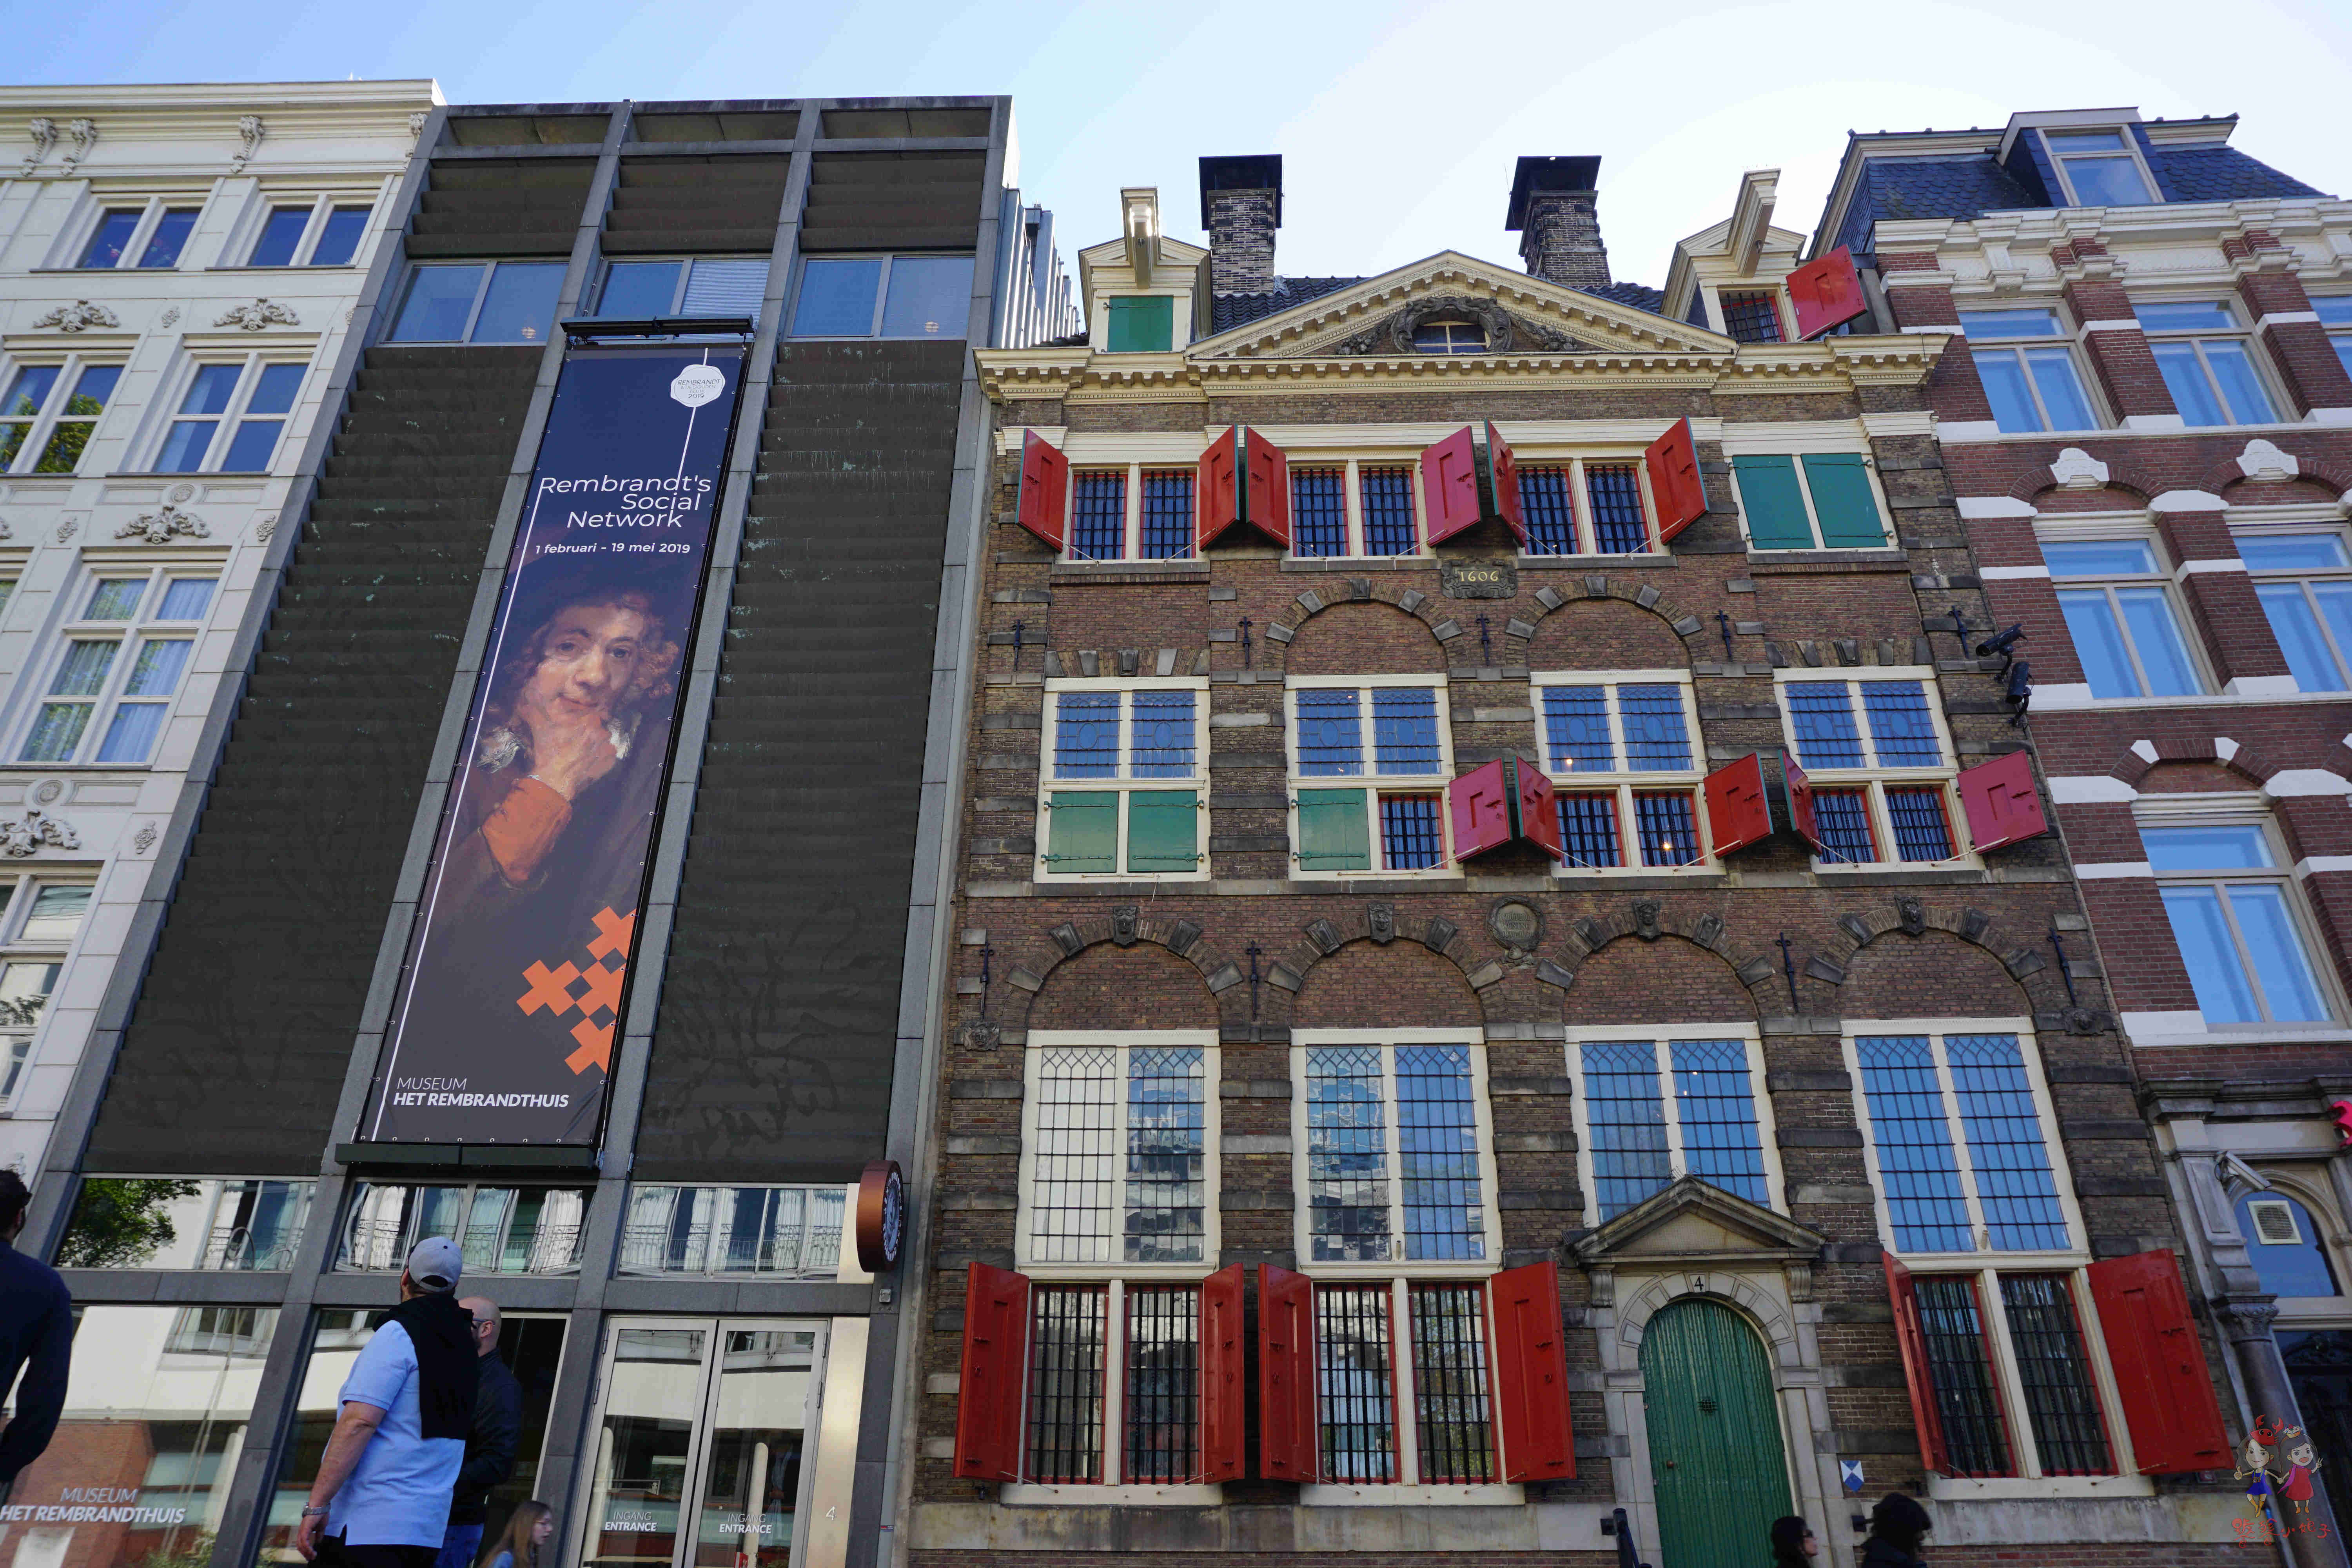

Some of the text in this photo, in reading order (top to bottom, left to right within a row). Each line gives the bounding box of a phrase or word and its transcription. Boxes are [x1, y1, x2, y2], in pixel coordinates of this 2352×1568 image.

[540, 475, 711, 494] Rembrandt's
[621, 493, 701, 510] Social
[567, 510, 682, 528] Network
[536, 545, 541, 554] 1
[544, 543, 597, 553] februari
[612, 543, 625, 552] 19
[629, 543, 655, 552] mei
[659, 543, 691, 553] 2019
[1460, 570, 1499, 582] 1606
[397, 1077, 467, 1090] MUSEUM
[393, 1093, 569, 1107] HET REMBRANDTHUIS
[1694, 1276, 1704, 1291] 4
[60, 1488, 138, 1503] MUSEUM
[0, 1505, 186, 1524] HET REMBRANDTHUIS
[613, 1511, 652, 1521] INGANG
[728, 1513, 766, 1523] INGANG
[826, 1506, 837, 1521] 4
[604, 1521, 657, 1532] ENTRANCE
[719, 1524, 772, 1534] ENTRANCE
